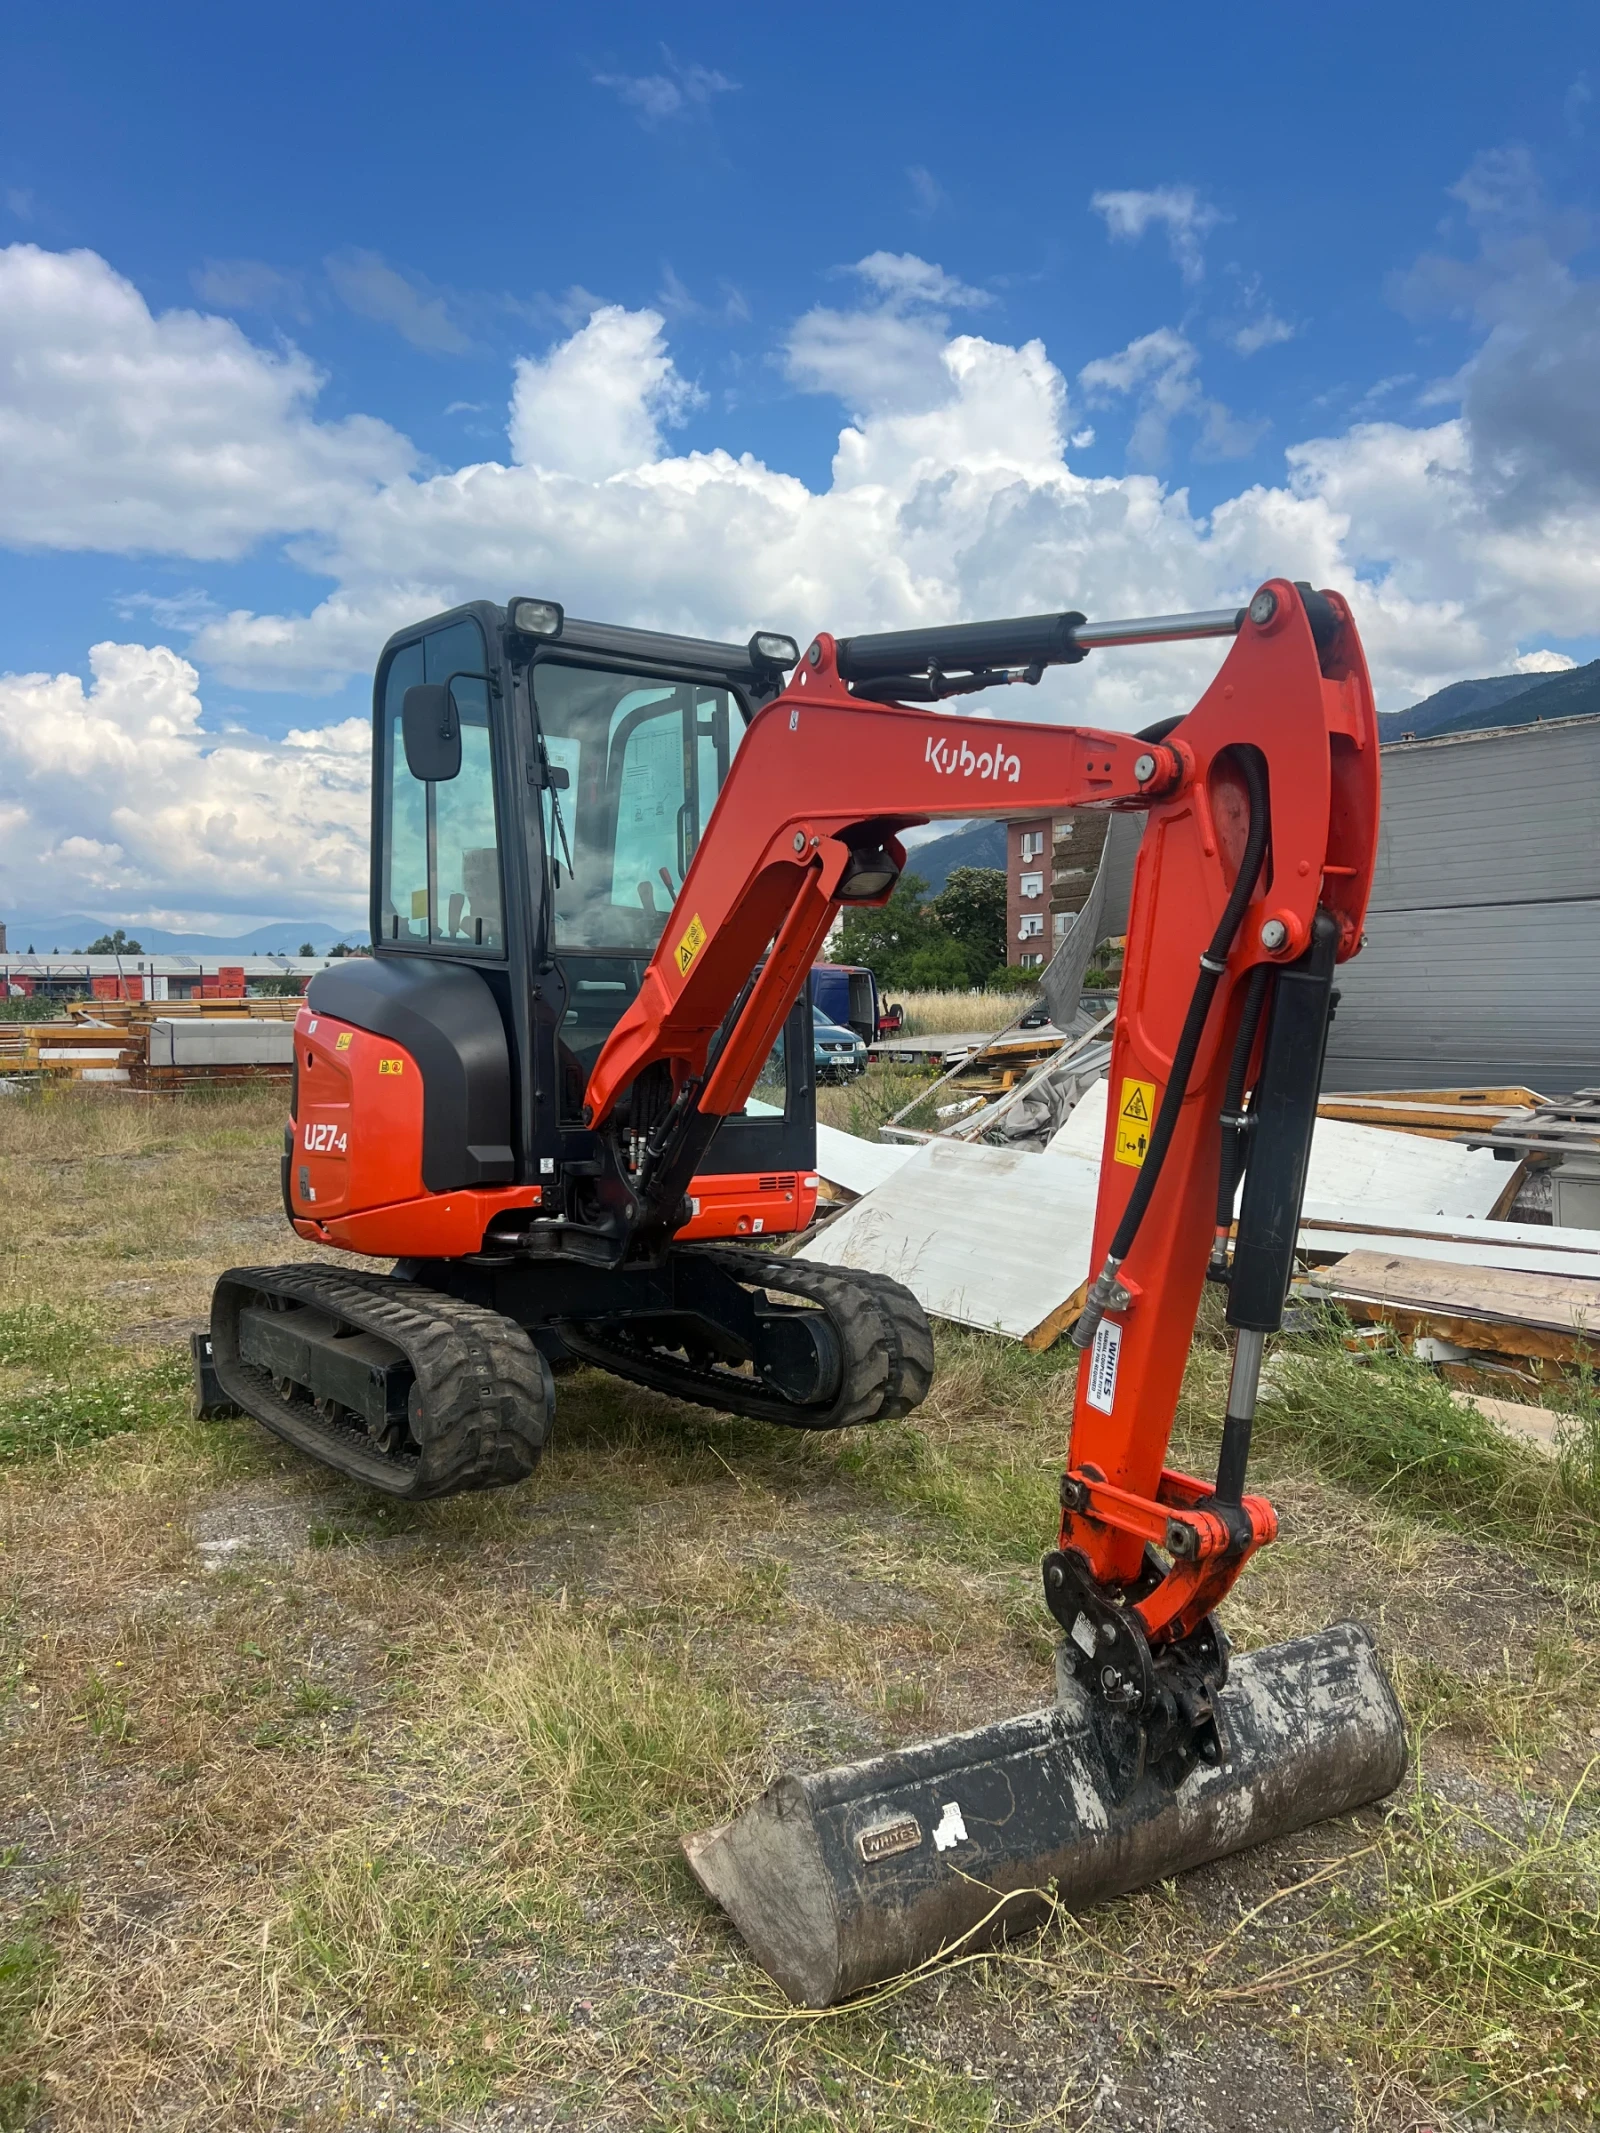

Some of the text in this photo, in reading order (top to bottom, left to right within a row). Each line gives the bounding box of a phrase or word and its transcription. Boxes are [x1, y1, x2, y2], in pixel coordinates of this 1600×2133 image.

[925, 736, 1021, 783] Kubota
[304, 1123, 348, 1152] U27-4
[1091, 1363, 1099, 1392] REQUIRED
[1103, 1341, 1117, 1397] WHITES
[869, 1827, 916, 1852] WHITES
